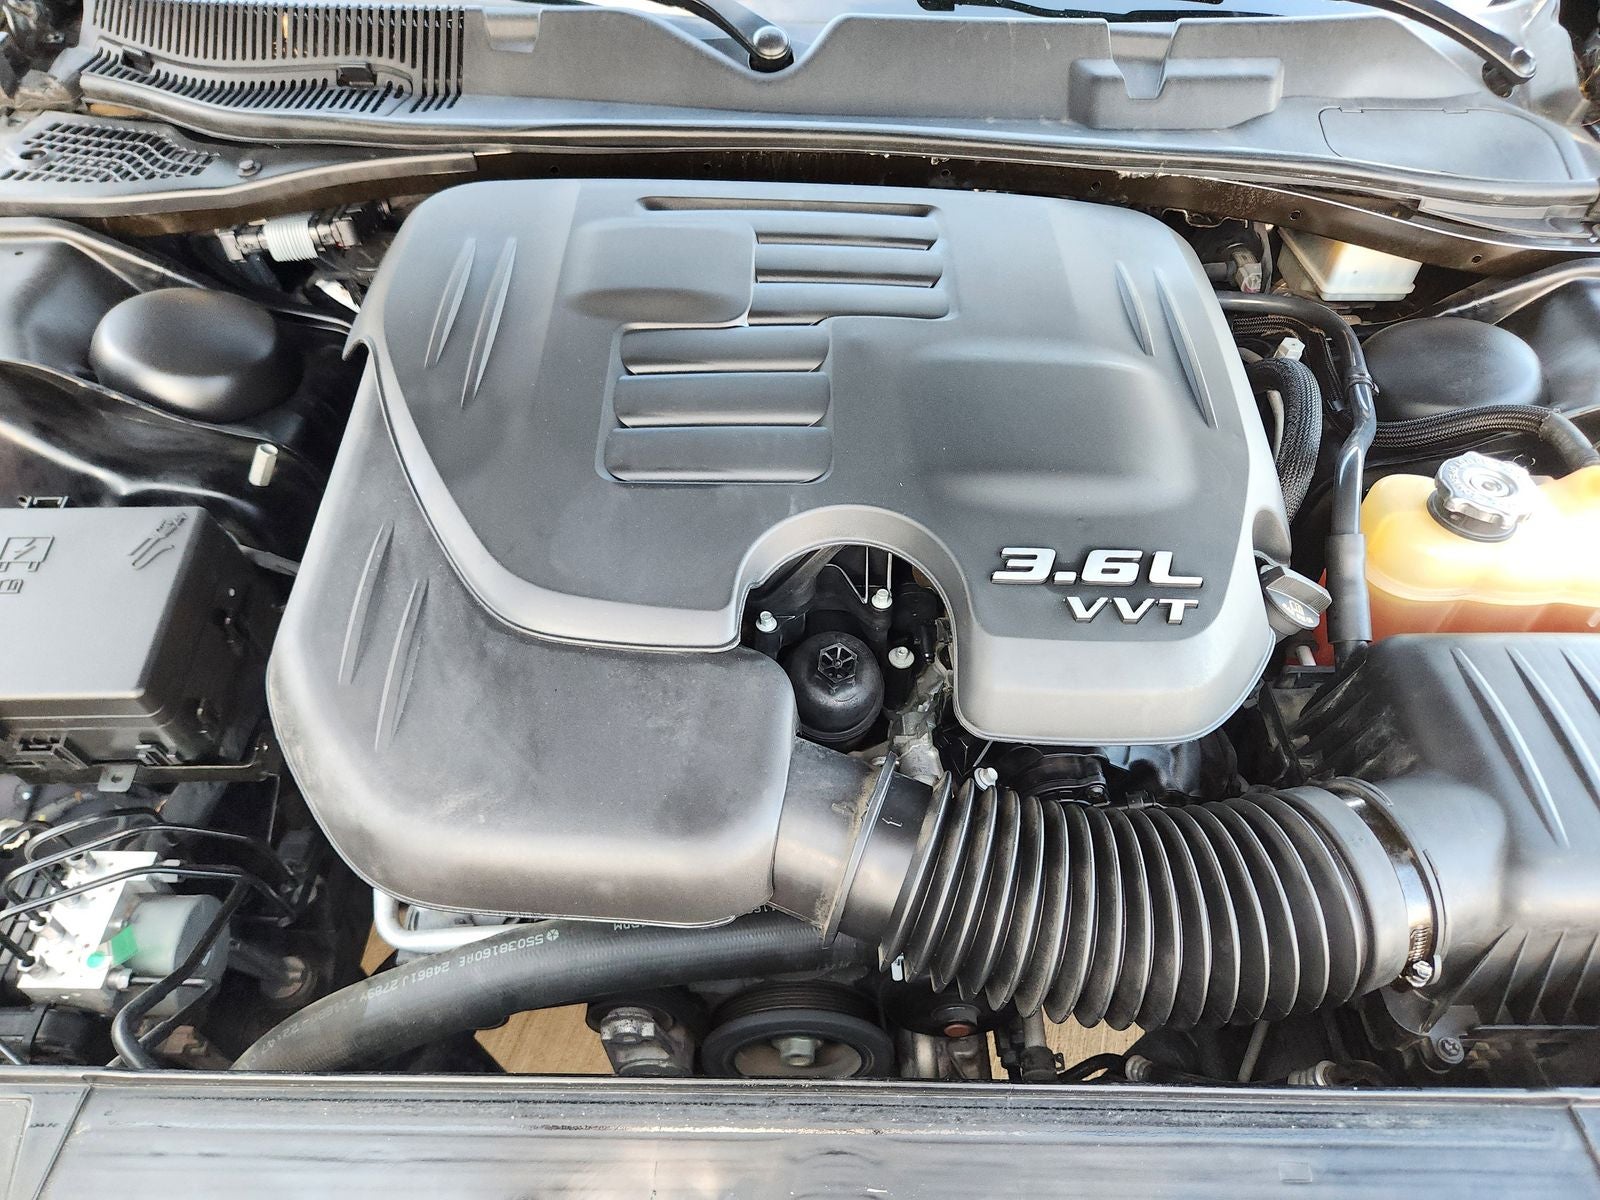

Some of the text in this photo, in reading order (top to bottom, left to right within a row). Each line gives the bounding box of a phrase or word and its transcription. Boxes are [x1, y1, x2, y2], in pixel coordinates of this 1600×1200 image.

[991, 547, 1204, 588] 3.6L
[1065, 597, 1199, 625] VVT
[459, 933, 545, 968] 55038160AE
